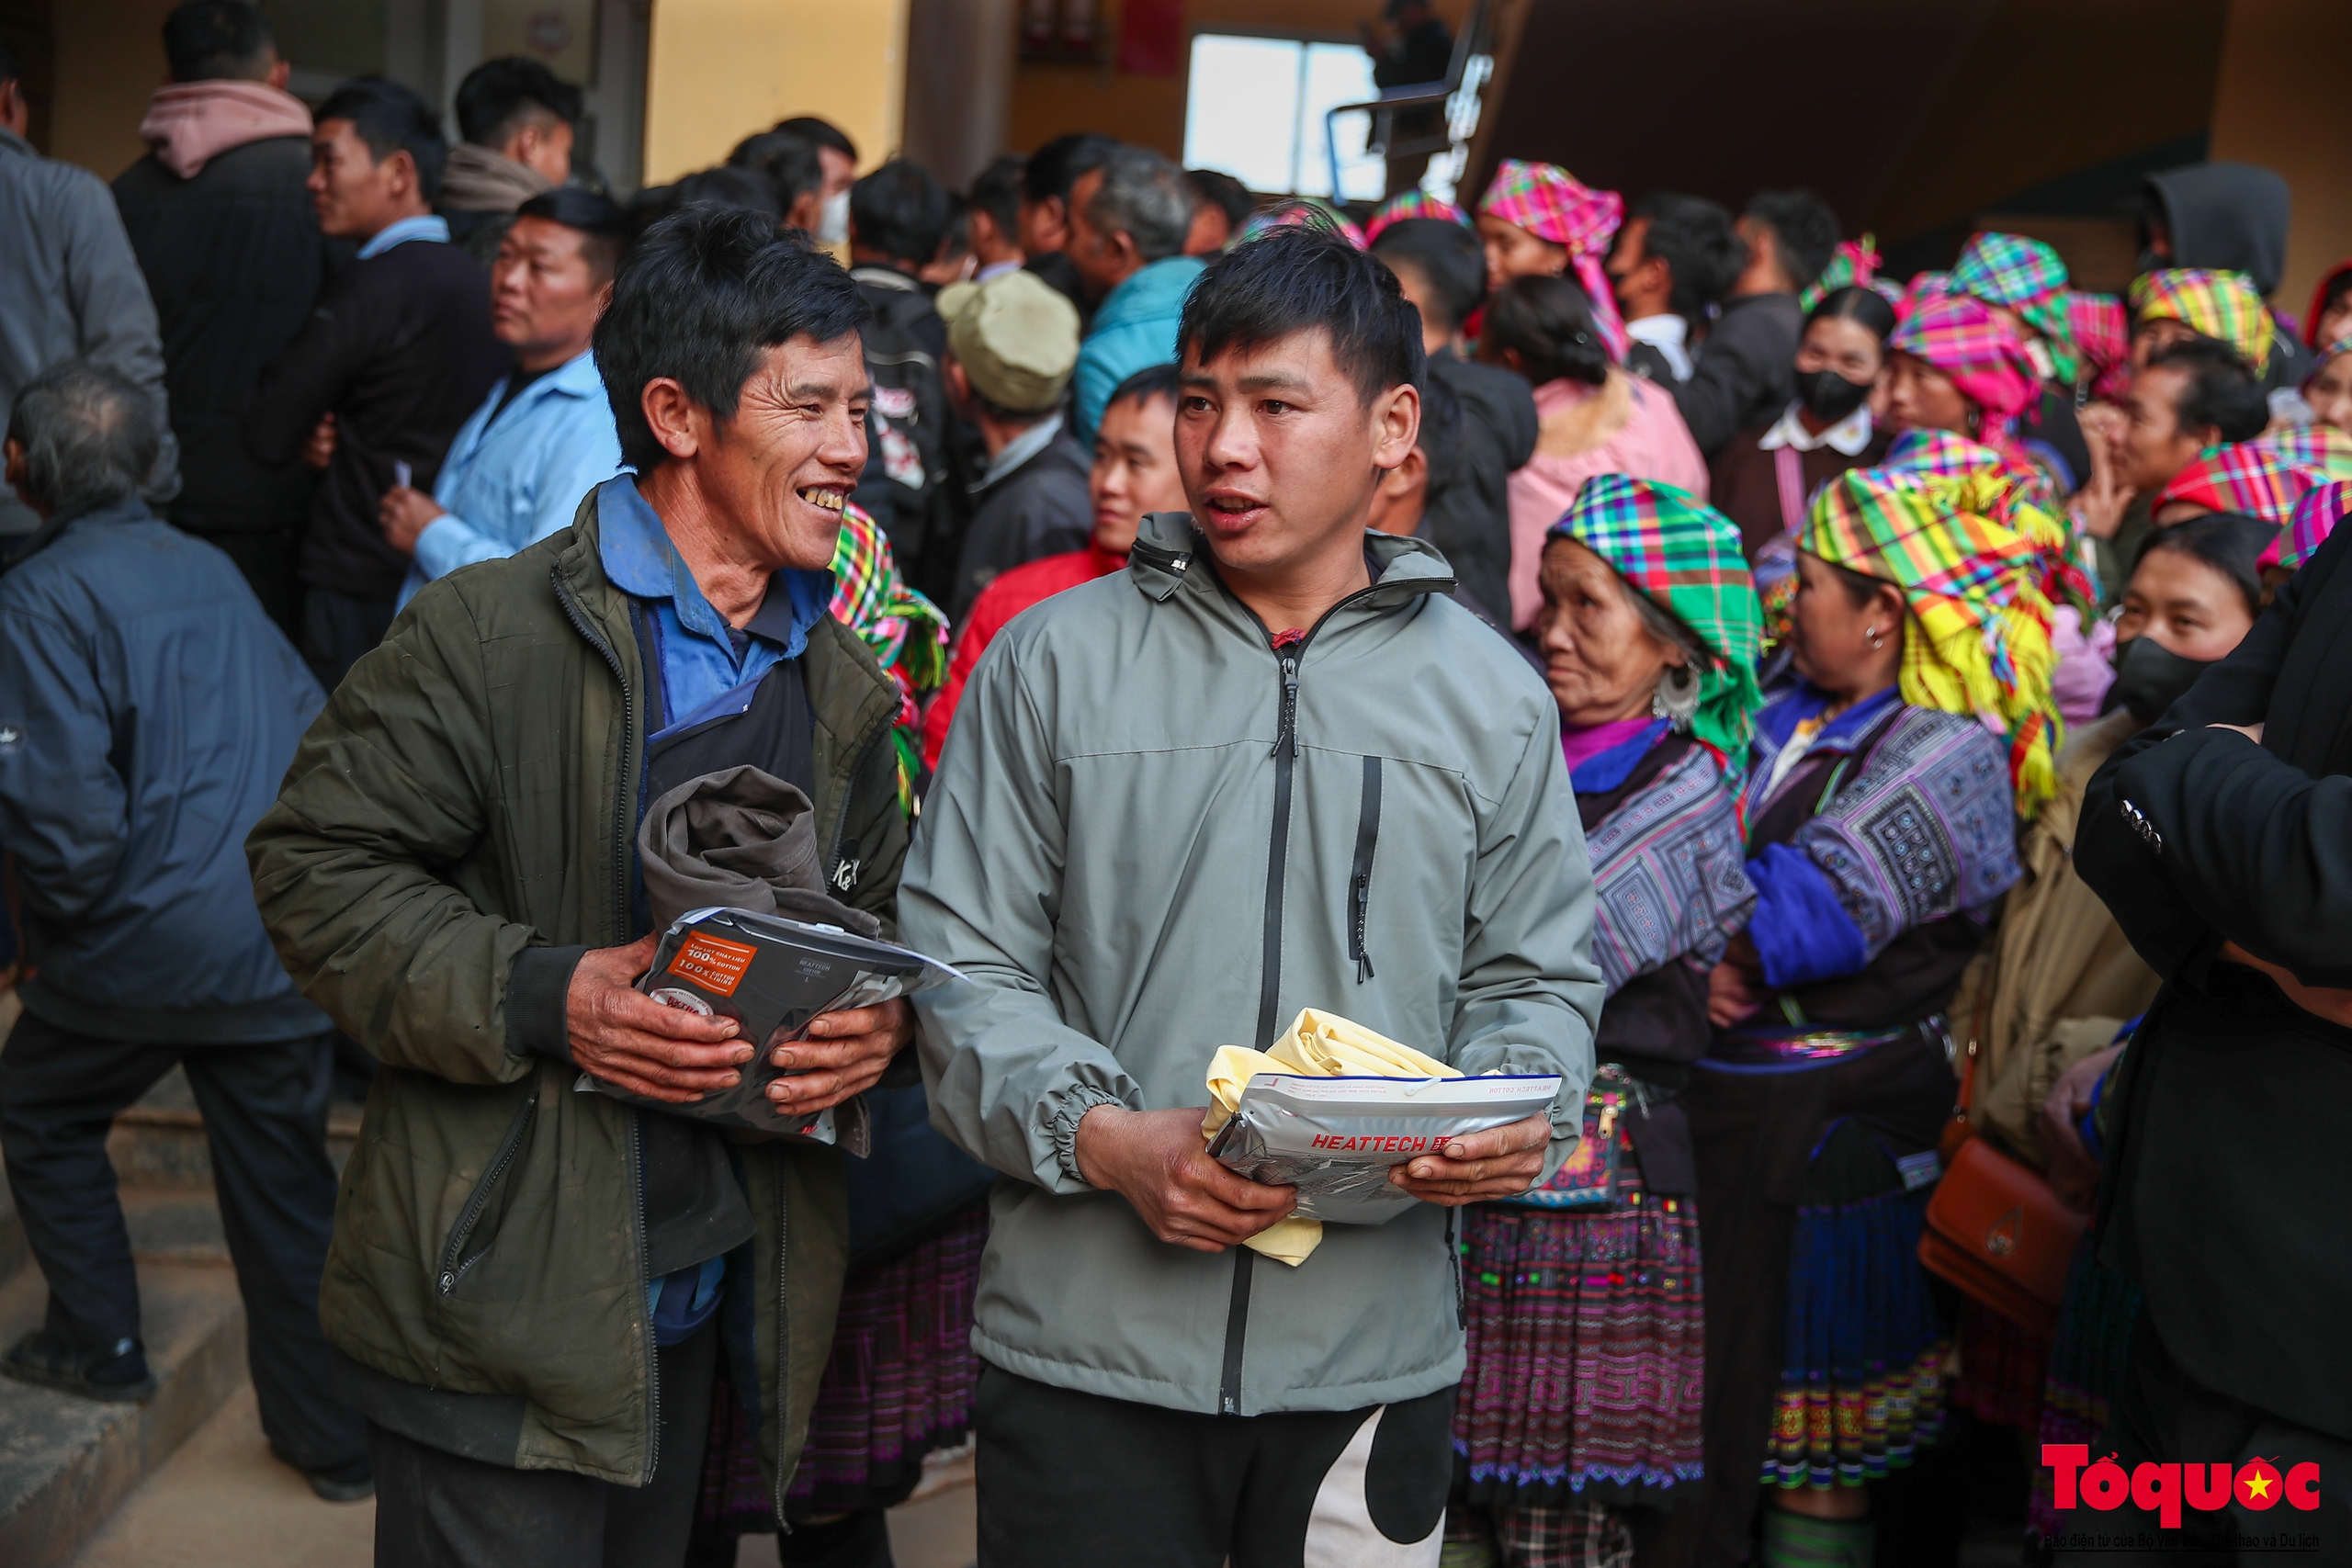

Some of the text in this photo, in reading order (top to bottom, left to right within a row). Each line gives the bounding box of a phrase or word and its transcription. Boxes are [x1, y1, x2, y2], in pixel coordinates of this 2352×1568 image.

[687, 949, 741, 972] 100% COTTON
[798, 959, 831, 972] HEATTECH
[708, 975, 733, 986] LINING
[712, 971, 736, 981] COTTON
[1311, 1134, 1427, 1153] HEATTECH
